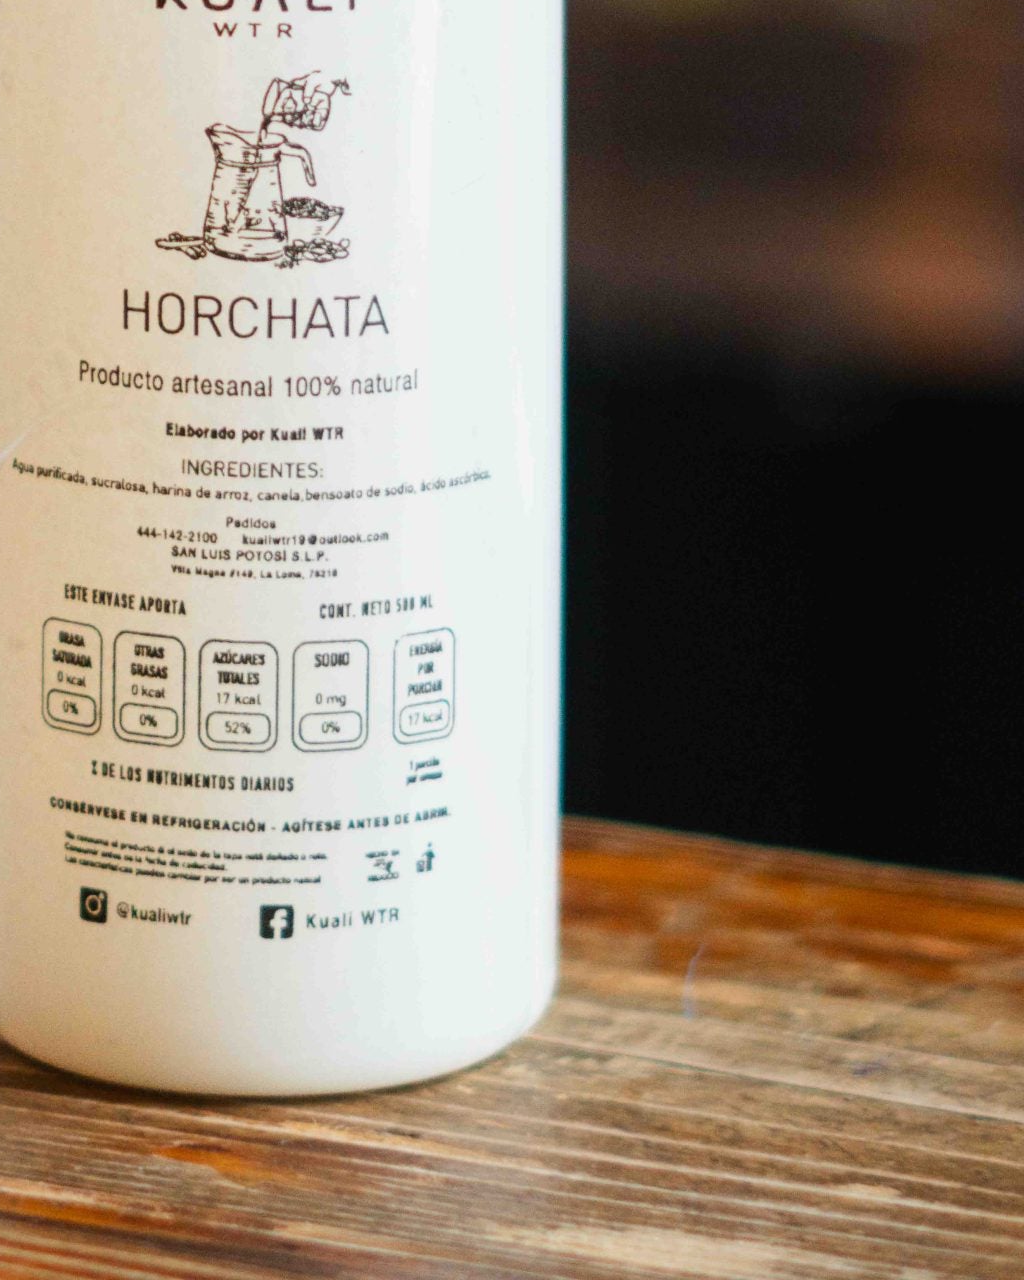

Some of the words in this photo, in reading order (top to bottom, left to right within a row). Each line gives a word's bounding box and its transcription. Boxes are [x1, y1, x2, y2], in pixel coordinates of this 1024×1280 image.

[213, 22, 293, 38] WTR
[123, 288, 389, 338] HORCHATA
[79, 359, 164, 391] Producto
[172, 374, 273, 398] artesanal
[284, 376, 341, 397] 100%
[351, 368, 418, 395] natural
[166, 422, 236, 440] Elaborado
[242, 428, 264, 443] por
[270, 427, 306, 441] Kuali
[313, 426, 344, 440] WTR
[182, 458, 324, 479] INGREDIENTES:
[12, 458, 35, 475] Agua
[37, 466, 88, 486] purificada,
[91, 476, 148, 495] sucralosa,
[152, 482, 192, 498] harina
[196, 487, 211, 499] de
[215, 490, 253, 502] arroz,
[367, 486, 381, 498] de
[385, 483, 416, 497] sodio,
[226, 516, 276, 529] Pedidos
[137, 526, 218, 543] 444-142-2100
[171, 545, 196, 558] SAN
[201, 548, 231, 560] LUIS
[64, 583, 88, 603] ESTE
[92, 588, 135, 610] ENVASE
[139, 595, 187, 616] APORTA
[320, 603, 356, 619] CONT.
[362, 599, 391, 617] NETO
[420, 594, 433, 609] ML
[134, 644, 165, 660] OTRAS
[212, 647, 266, 666] AZÚCARES
[314, 651, 350, 668] SODIO
[130, 662, 168, 680] GRASAS
[217, 671, 260, 685] TOTALES
[131, 684, 138, 696] 0
[141, 685, 166, 699] kcal
[216, 692, 230, 705] 17
[234, 693, 261, 706] kcal
[315, 692, 322, 705] 0
[326, 693, 347, 707] mg
[63, 699, 79, 715] 0%
[139, 713, 158, 728] 0%
[225, 721, 251, 734] 52%
[321, 721, 341, 734] 0%
[102, 762, 115, 778] DE
[120, 765, 142, 783] LOS
[147, 769, 235, 791] NUTRIMENTOS
[241, 776, 294, 792] DIARIOS
[131, 810, 147, 825] EN
[152, 813, 266, 833] REFRIGERACIÓN
[347, 815, 389, 830] ANTES
[394, 812, 409, 825] DE
[116, 900, 192, 926] @kualiwtr
[306, 913, 353, 929] Kuali
[361, 908, 400, 925] WTR
